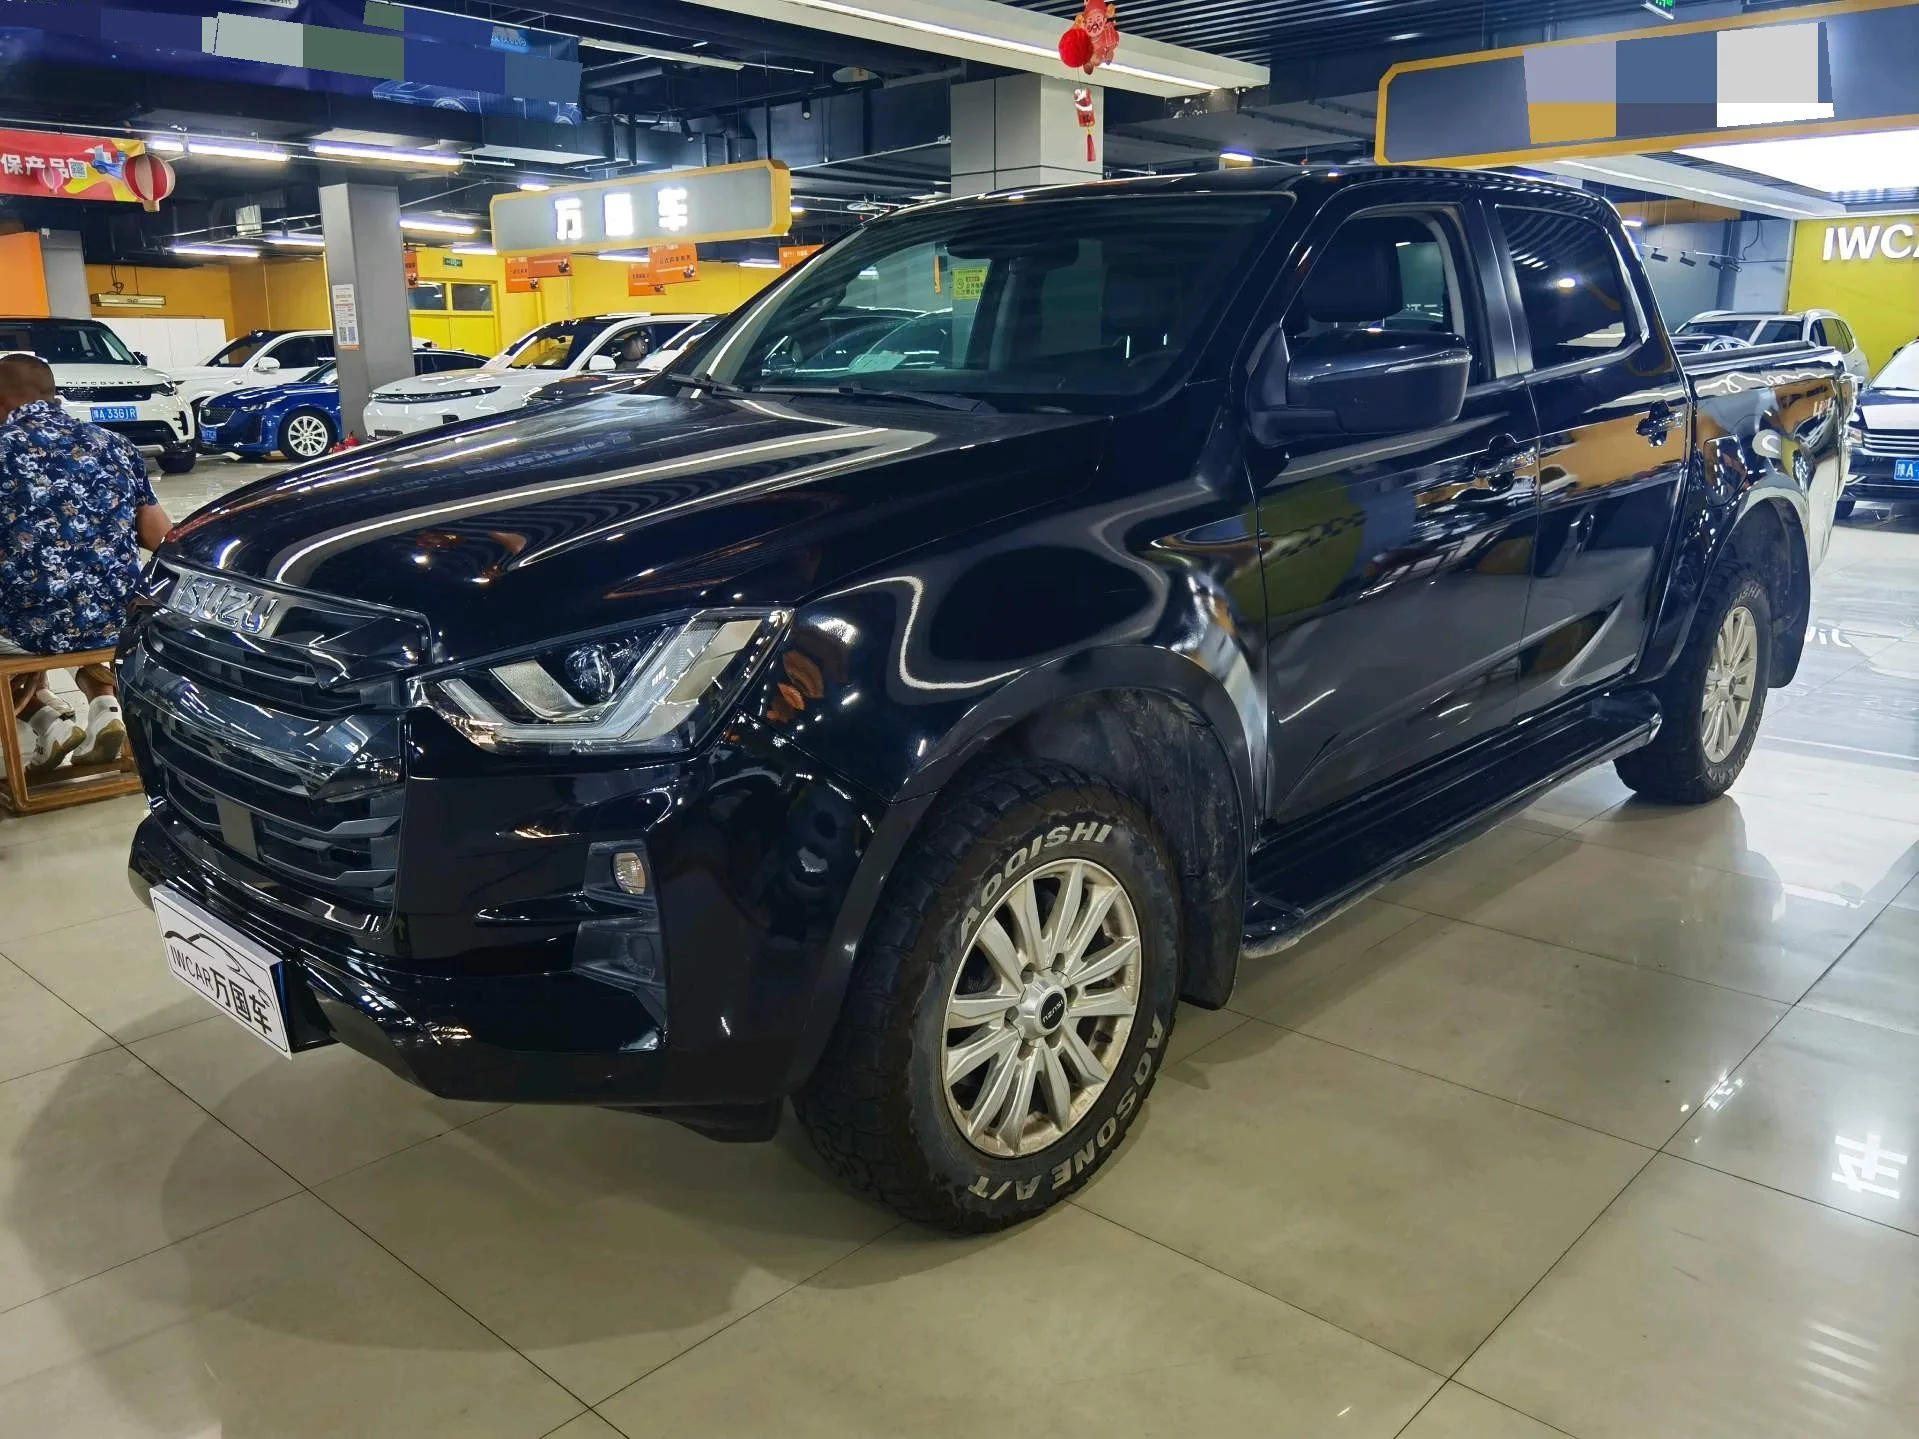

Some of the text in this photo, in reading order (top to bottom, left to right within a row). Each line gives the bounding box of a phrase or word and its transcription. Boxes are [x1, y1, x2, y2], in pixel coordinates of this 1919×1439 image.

[0, 153, 87, 179] 保产品
[173, 575, 279, 634] ISUZU
[968, 1012, 1163, 1200] AOSONE A/T
